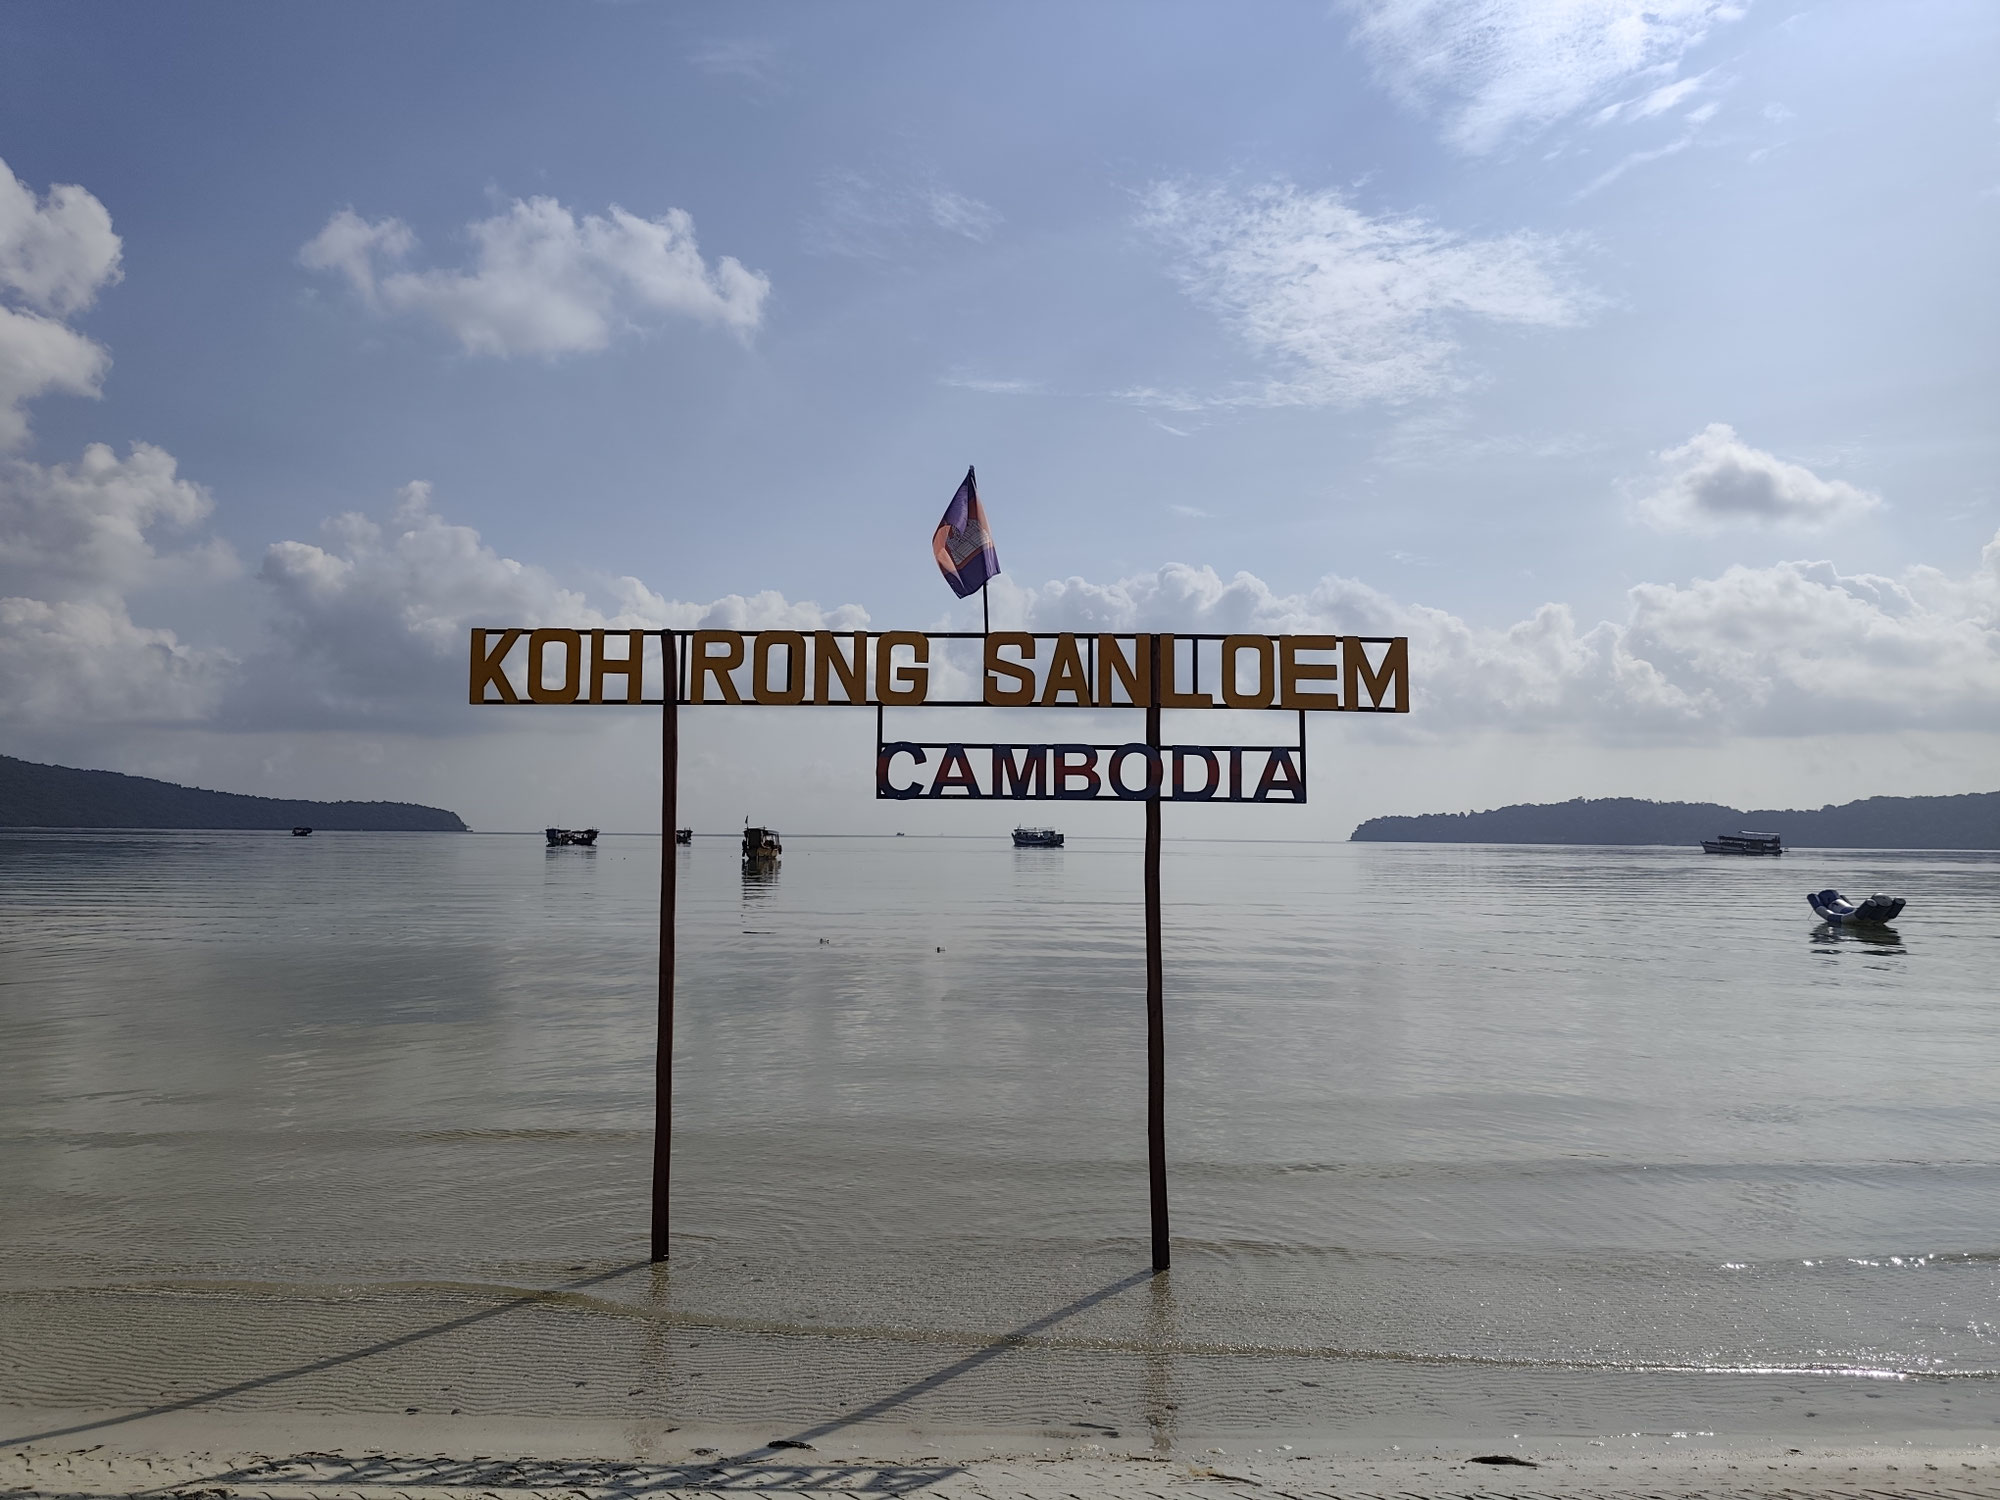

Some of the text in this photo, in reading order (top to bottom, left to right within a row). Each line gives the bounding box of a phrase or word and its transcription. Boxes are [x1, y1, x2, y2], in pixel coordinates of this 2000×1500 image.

[470, 628, 1409, 712] KOH RONG SANLOEM
[877, 741, 1306, 801] CAMBODIA
